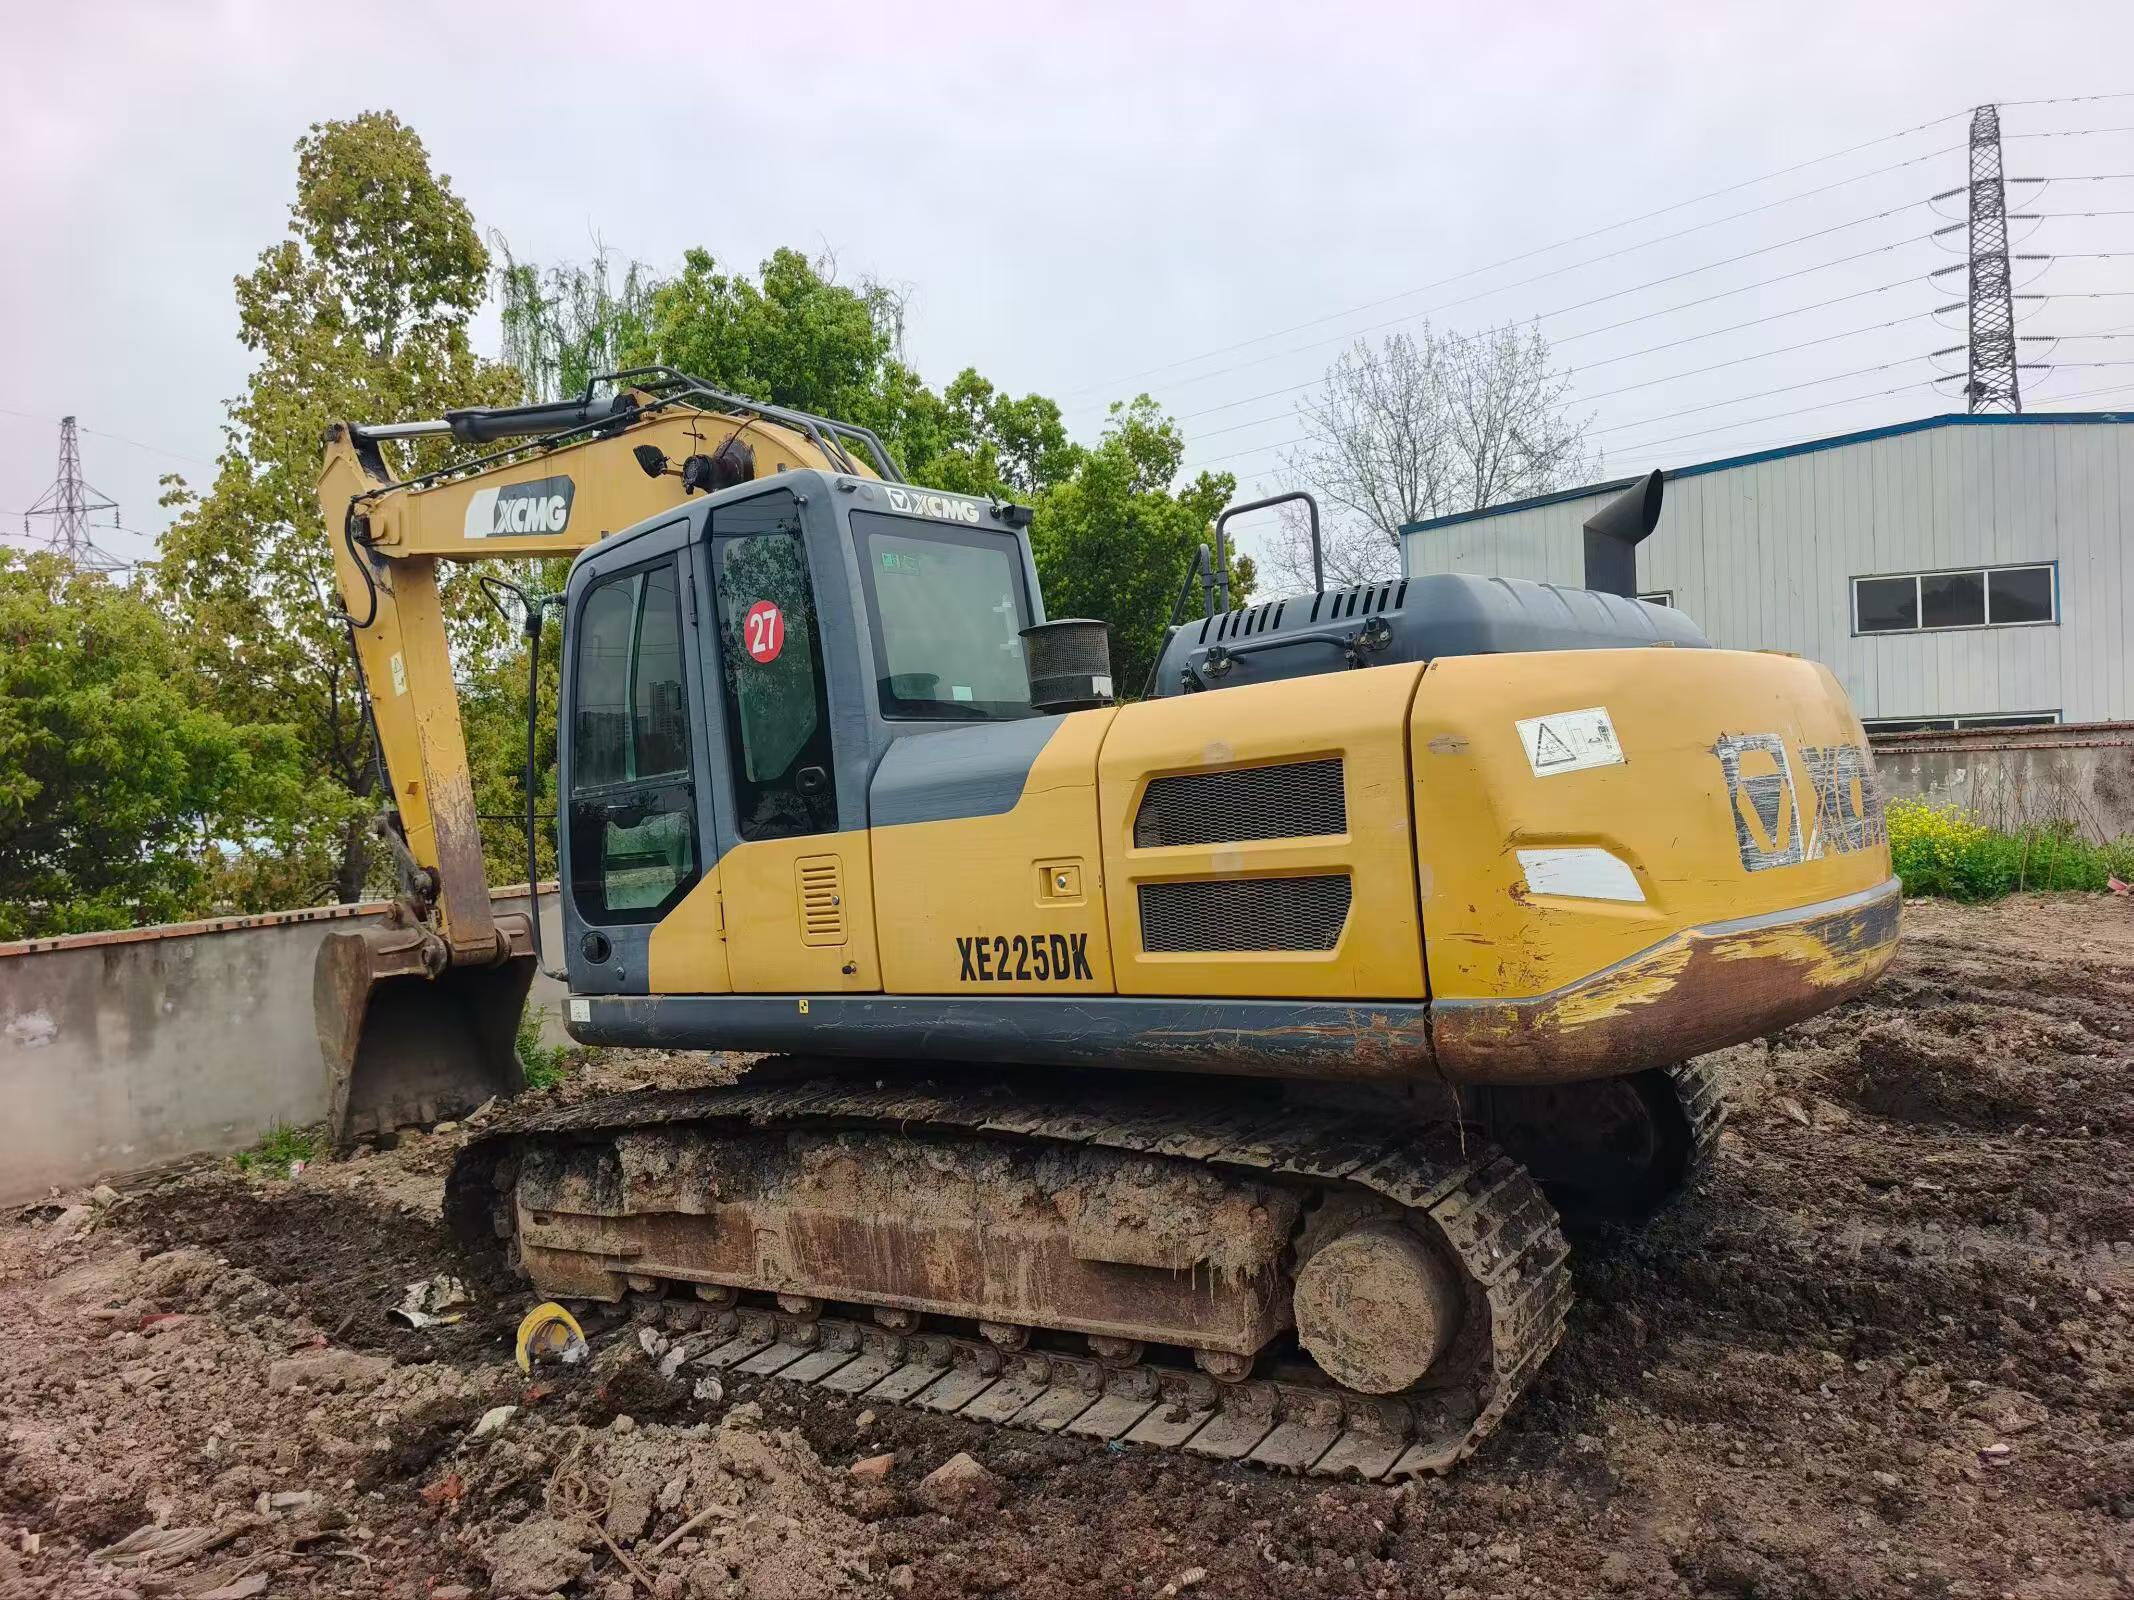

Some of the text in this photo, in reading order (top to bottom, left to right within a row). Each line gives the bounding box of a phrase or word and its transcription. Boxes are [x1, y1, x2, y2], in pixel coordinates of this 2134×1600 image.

[495, 495, 567, 534] XCMG
[910, 493, 980, 523] XCMG
[750, 608, 777, 654] 27
[956, 933, 1093, 981] XE225DK
